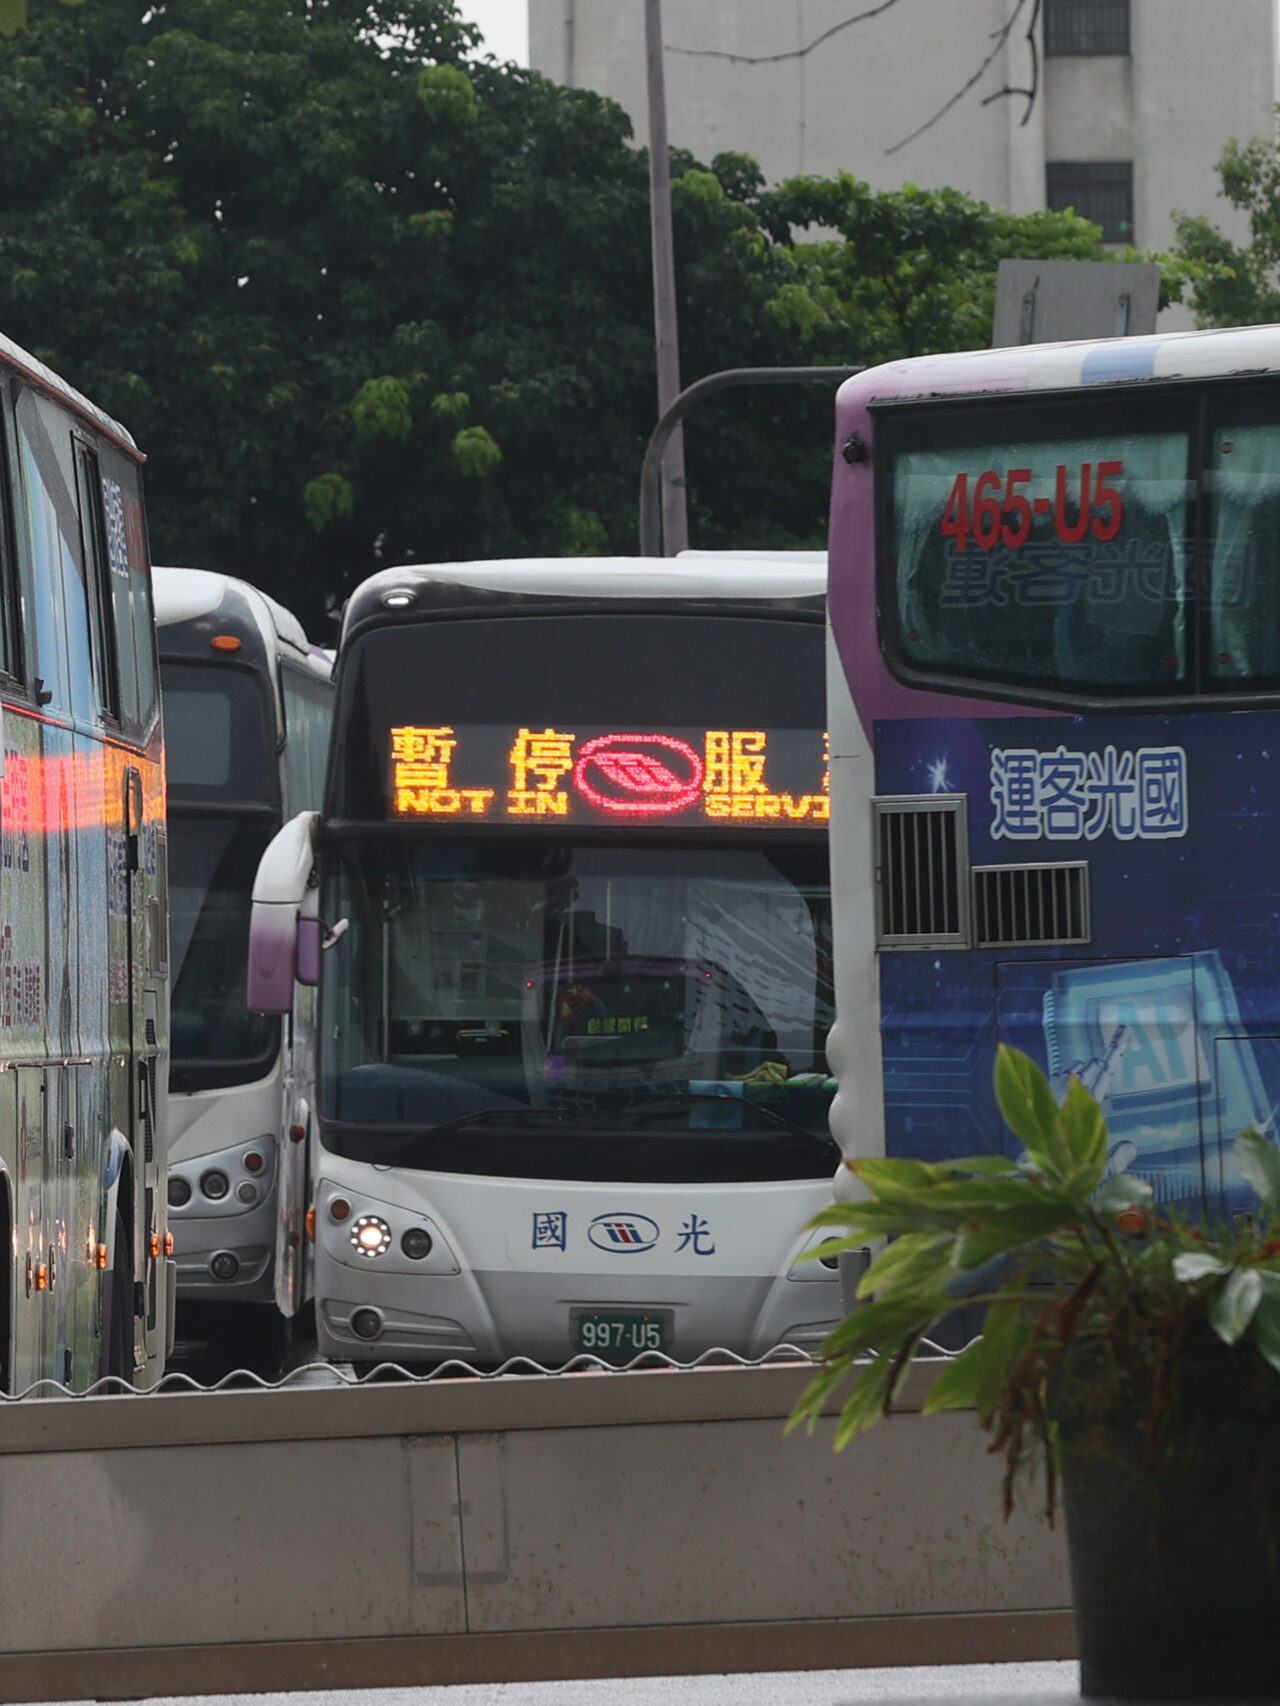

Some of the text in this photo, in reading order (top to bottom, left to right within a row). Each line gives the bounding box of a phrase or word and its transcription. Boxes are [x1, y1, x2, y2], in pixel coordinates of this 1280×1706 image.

[941, 461, 1123, 552] 465-U5
[396, 790, 494, 813] NOT
[508, 792, 567, 815] IN
[1117, 997, 1189, 1087] AI
[582, 1322, 661, 1349] 997-U5
